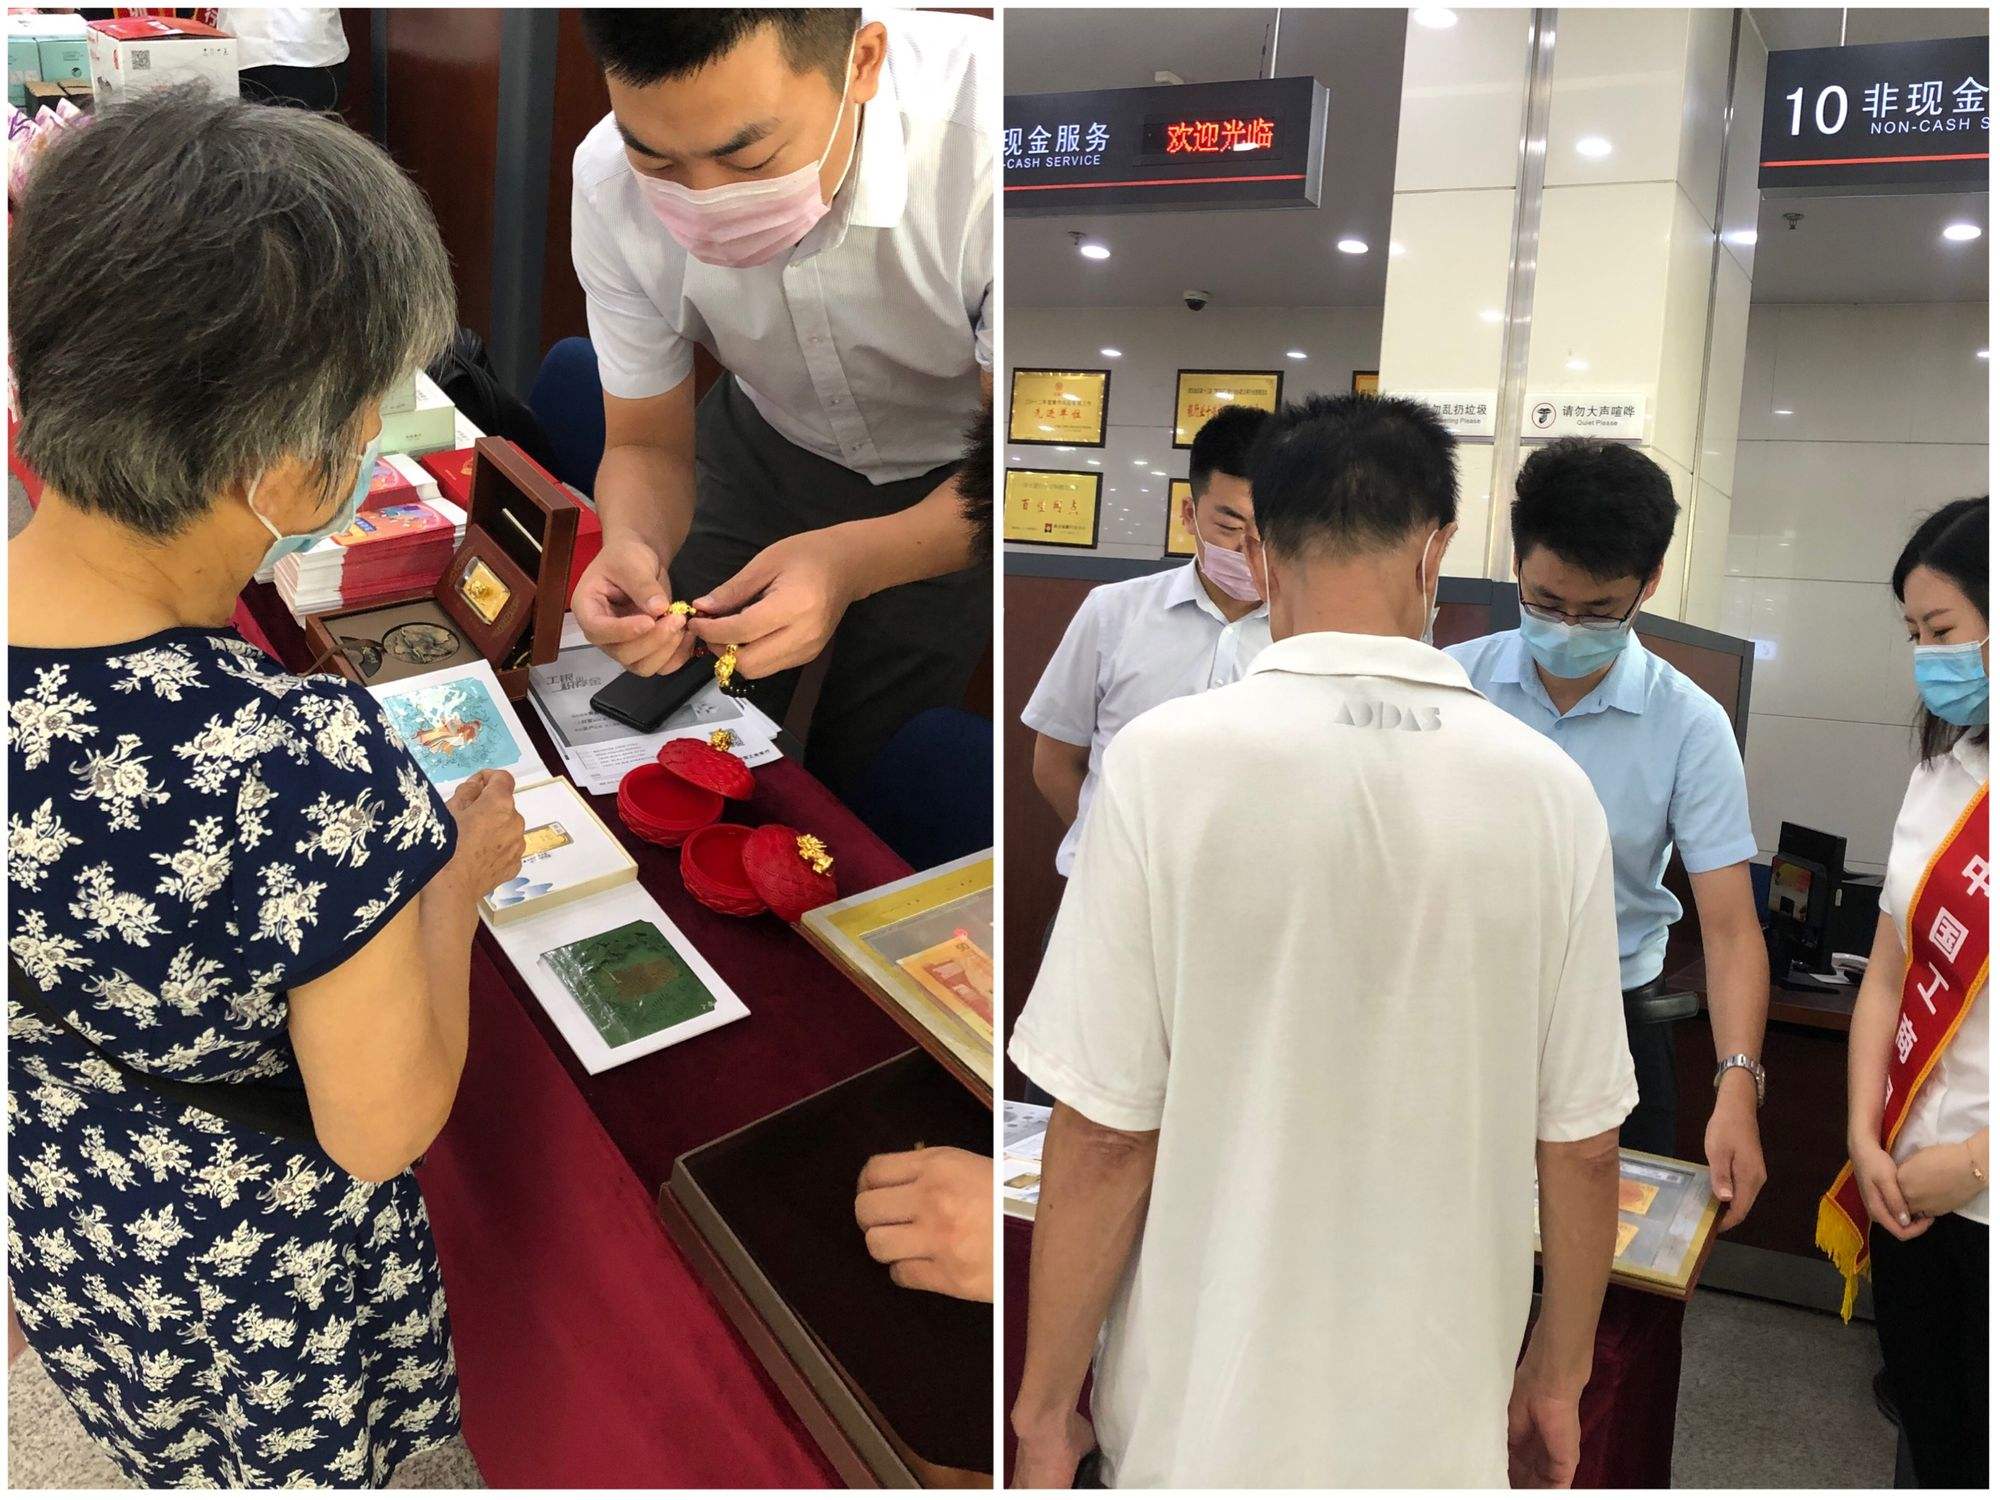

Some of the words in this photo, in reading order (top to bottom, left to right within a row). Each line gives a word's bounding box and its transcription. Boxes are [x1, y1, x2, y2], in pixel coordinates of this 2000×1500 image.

[1786, 85, 1849, 136] 10
[1862, 76, 1989, 119] 非现金
[1003, 121, 1111, 156] 现金服务
[1166, 117, 1274, 154] 欢迎光临
[1870, 117, 1970, 135] NON-CASH
[1046, 154, 1101, 167] SERVICE
[1562, 405, 1635, 417] 请勿大声喧哗
[1334, 701, 1442, 732] ADIDAS
